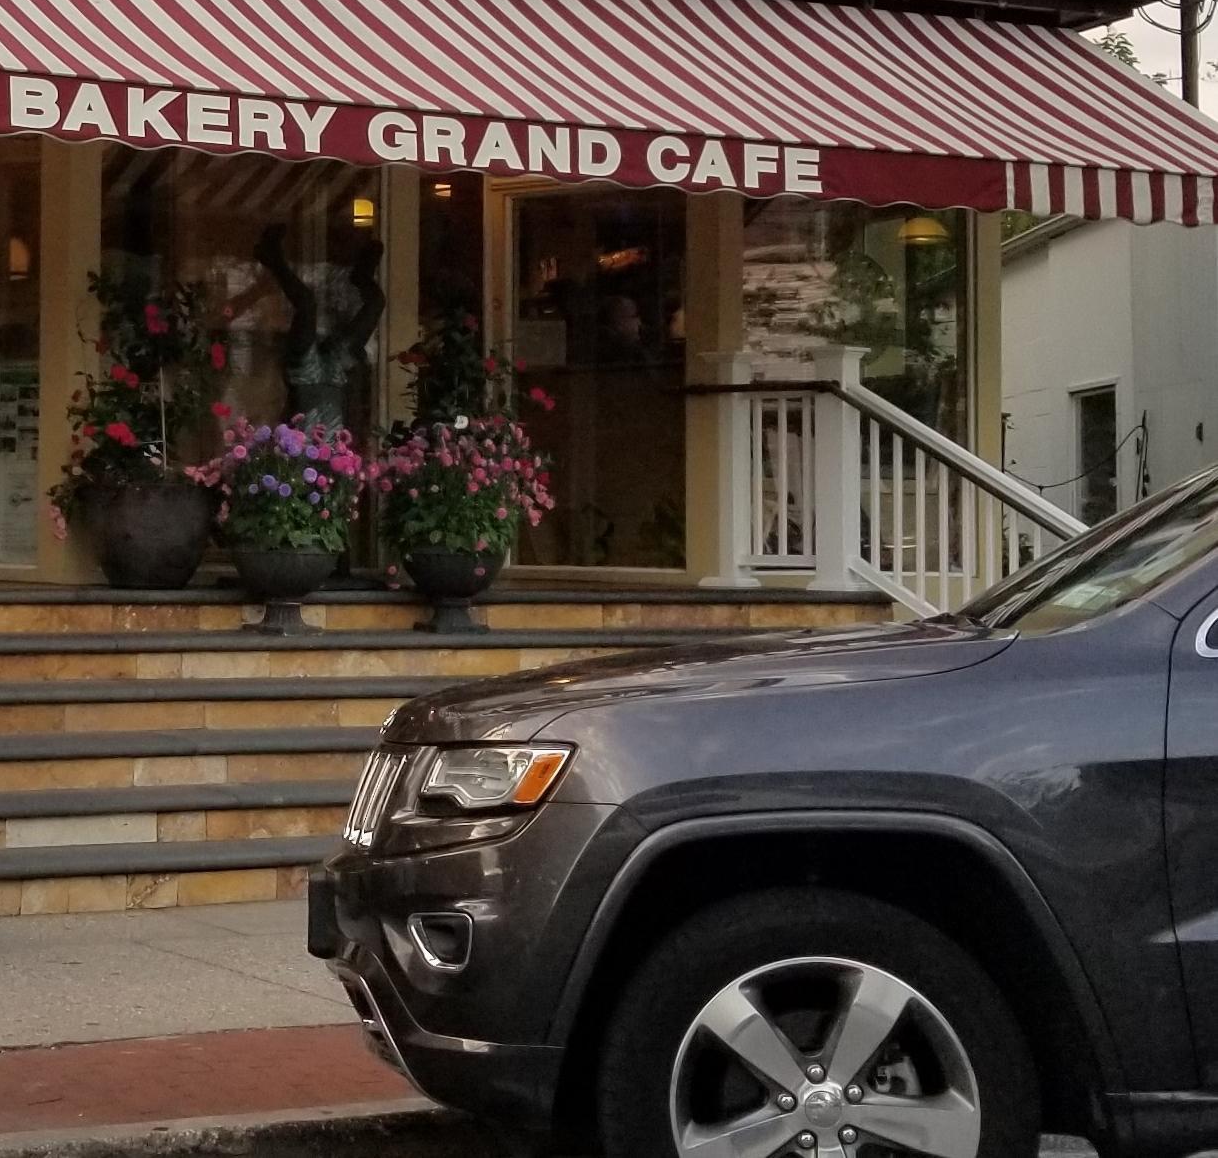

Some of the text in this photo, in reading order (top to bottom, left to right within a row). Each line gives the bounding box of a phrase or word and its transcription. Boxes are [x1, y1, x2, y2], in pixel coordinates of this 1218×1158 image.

[9, 75, 337, 154] BAKERY
[367, 111, 622, 177] GRAND
[646, 136, 823, 194] CAFE
